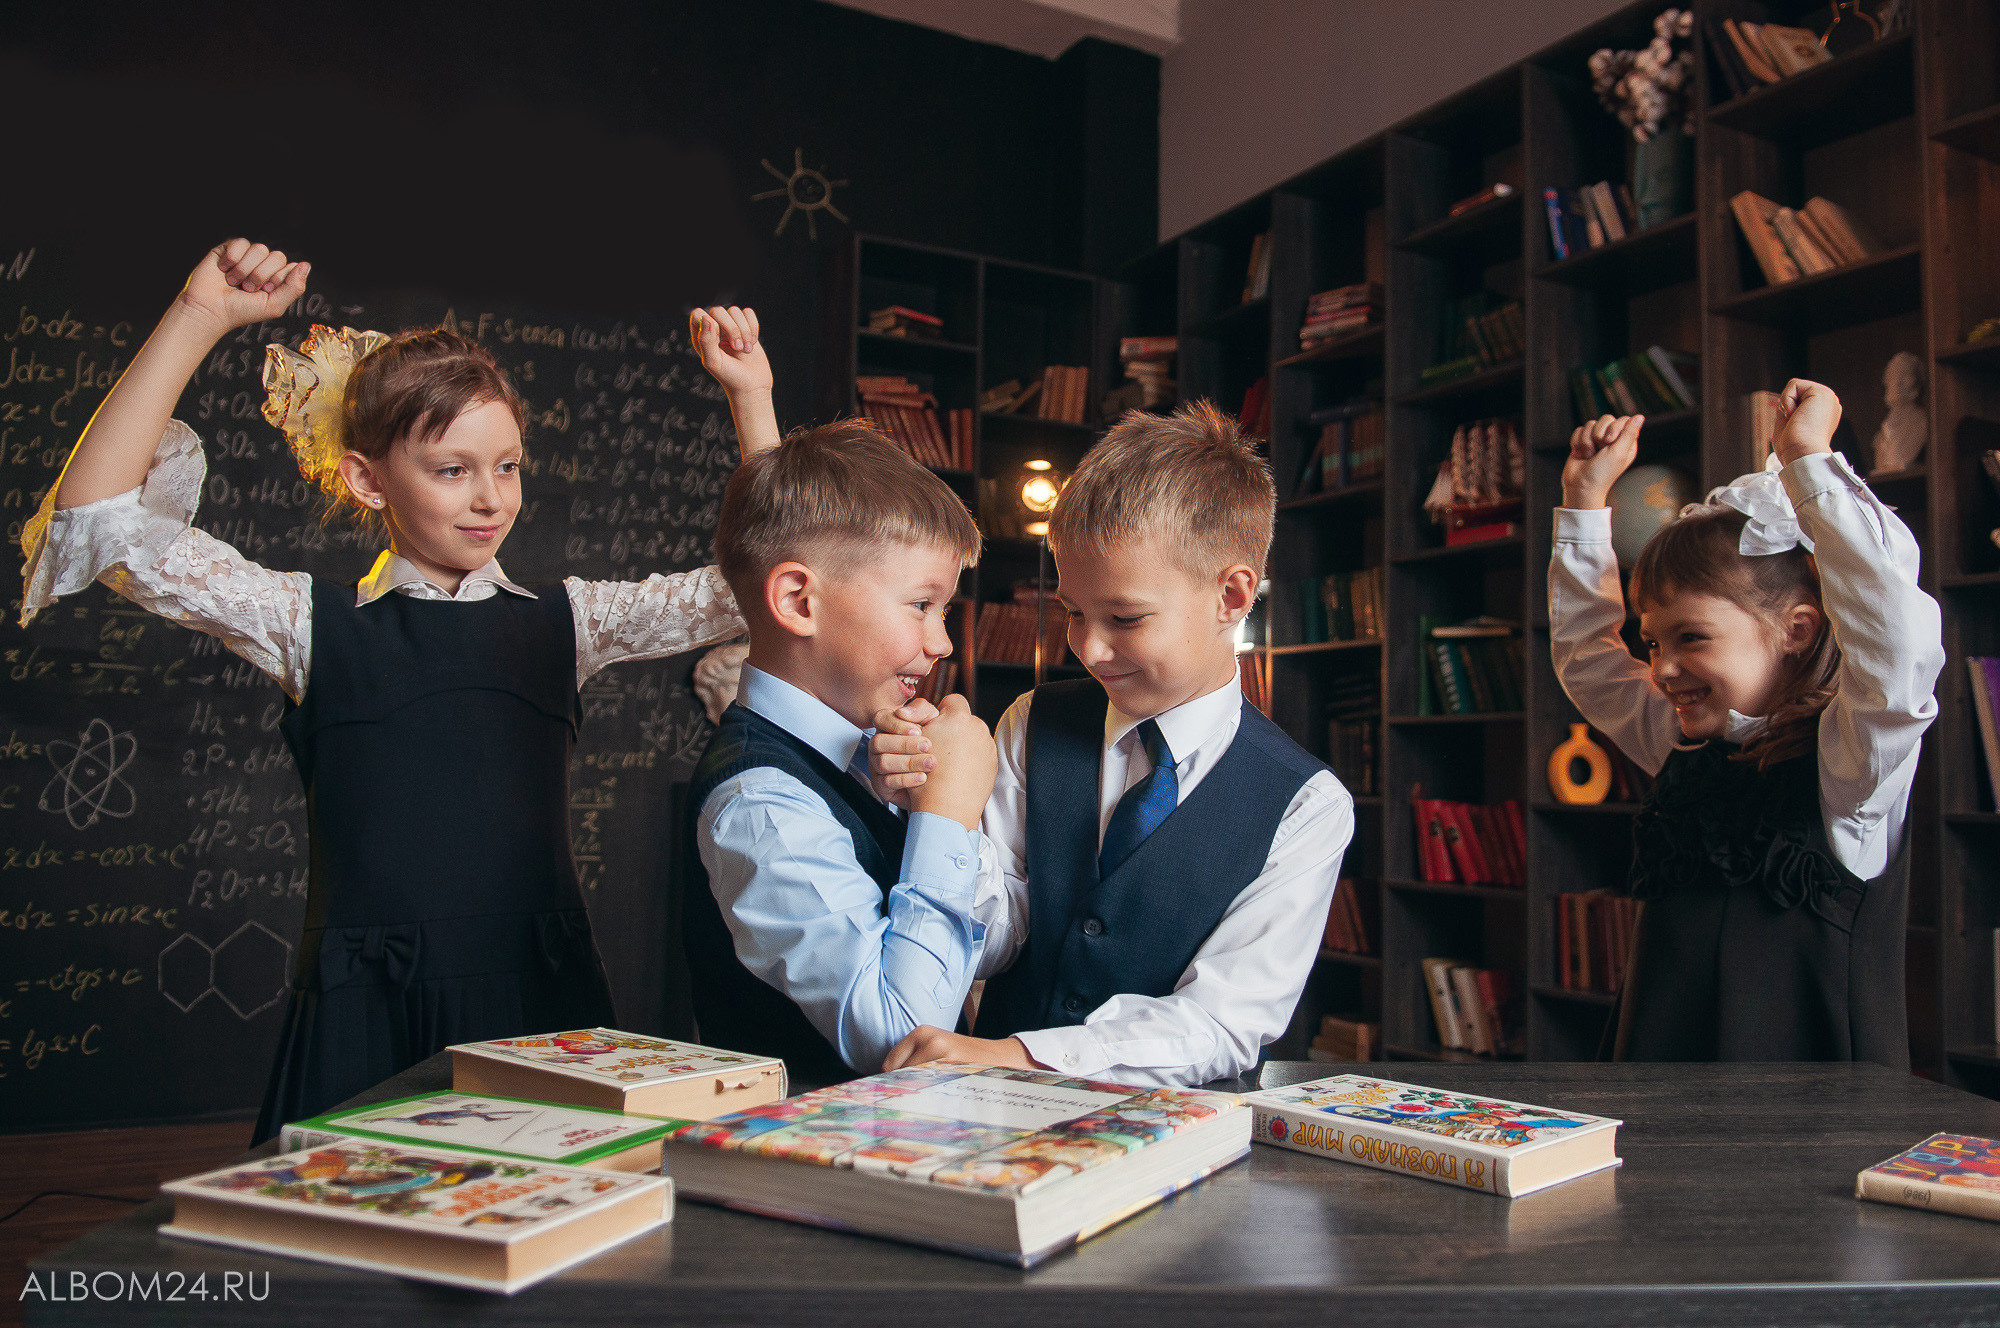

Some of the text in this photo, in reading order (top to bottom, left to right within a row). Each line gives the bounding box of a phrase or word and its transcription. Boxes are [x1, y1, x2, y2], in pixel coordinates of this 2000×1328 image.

[1292, 1121, 1486, 1187] Я ПОЗНАЮ МИР
[1902, 1185, 1932, 1206] (1986)
